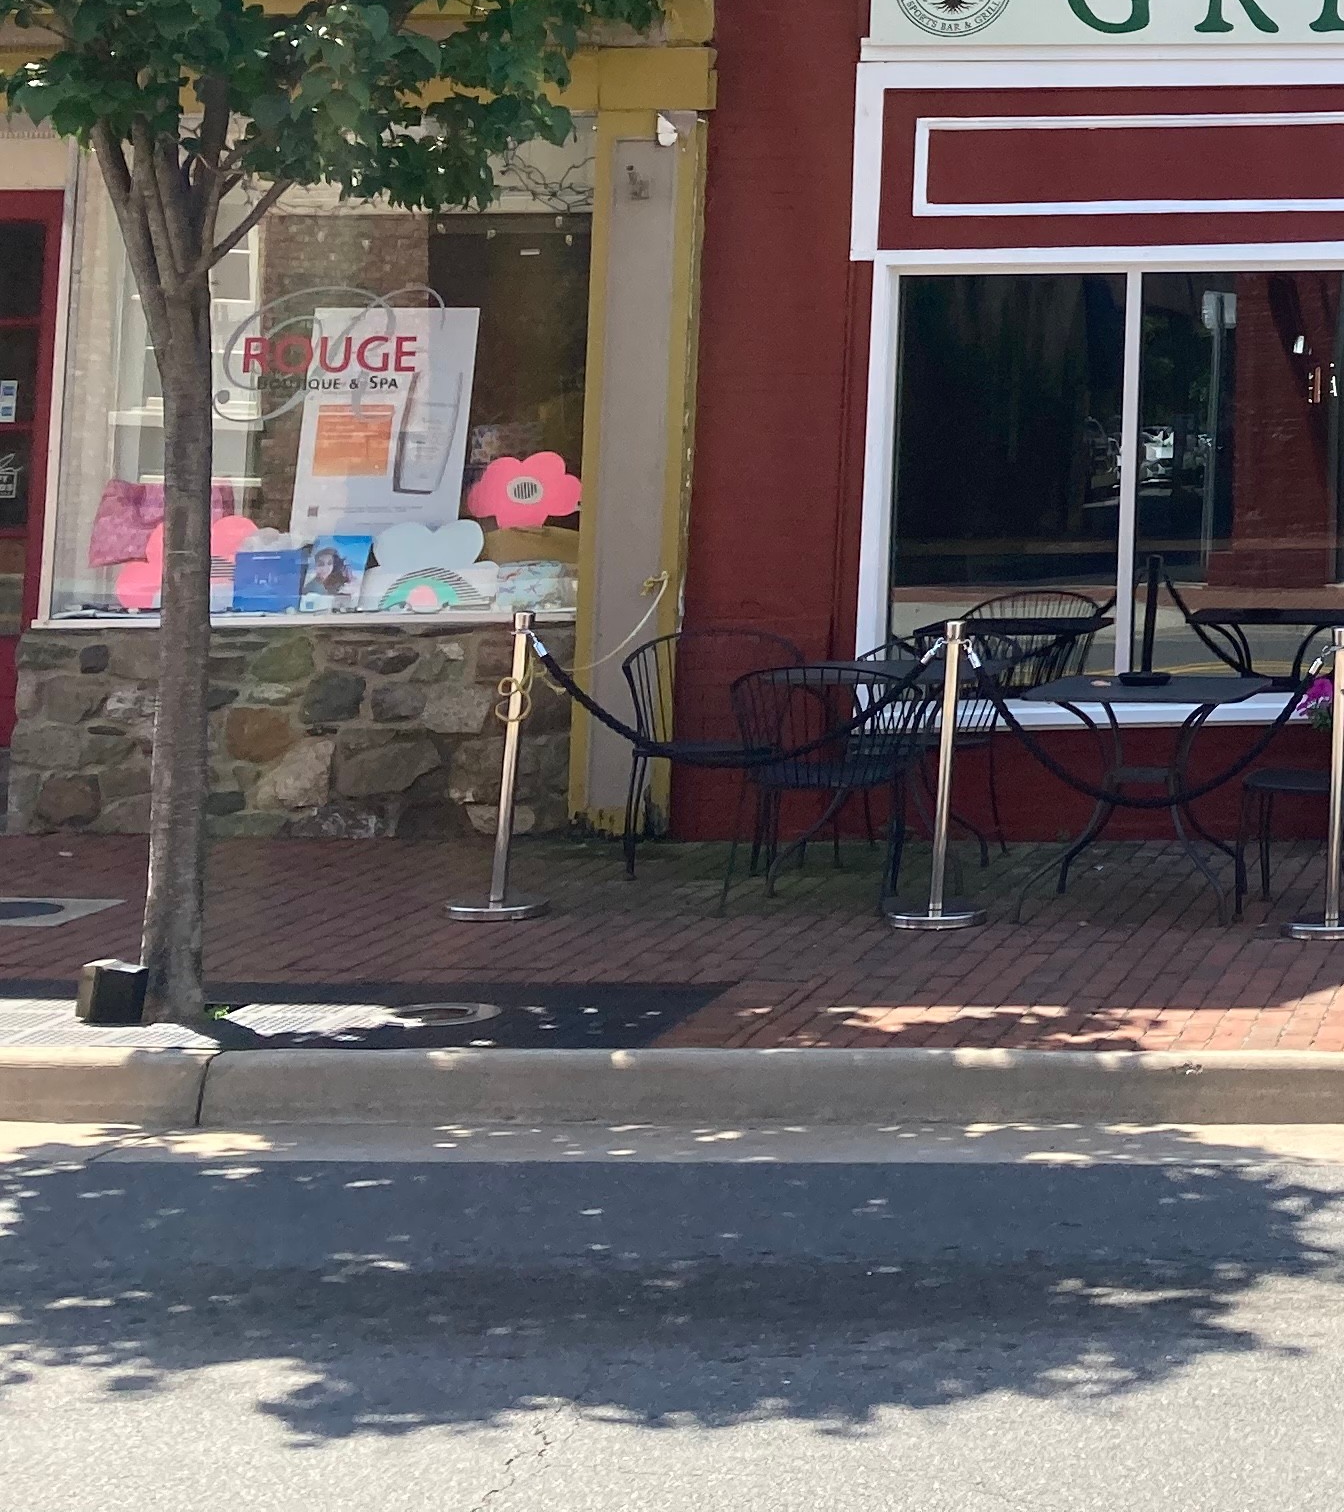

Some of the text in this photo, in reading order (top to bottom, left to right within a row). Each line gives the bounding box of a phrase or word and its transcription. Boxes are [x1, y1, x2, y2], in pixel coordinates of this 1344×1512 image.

[905, 0, 938, 28] SPORTS
[939, 21, 961, 31] BAR
[963, 20, 972, 28] &
[242, 336, 417, 373] ROUGE
[349, 378, 359, 389] &
